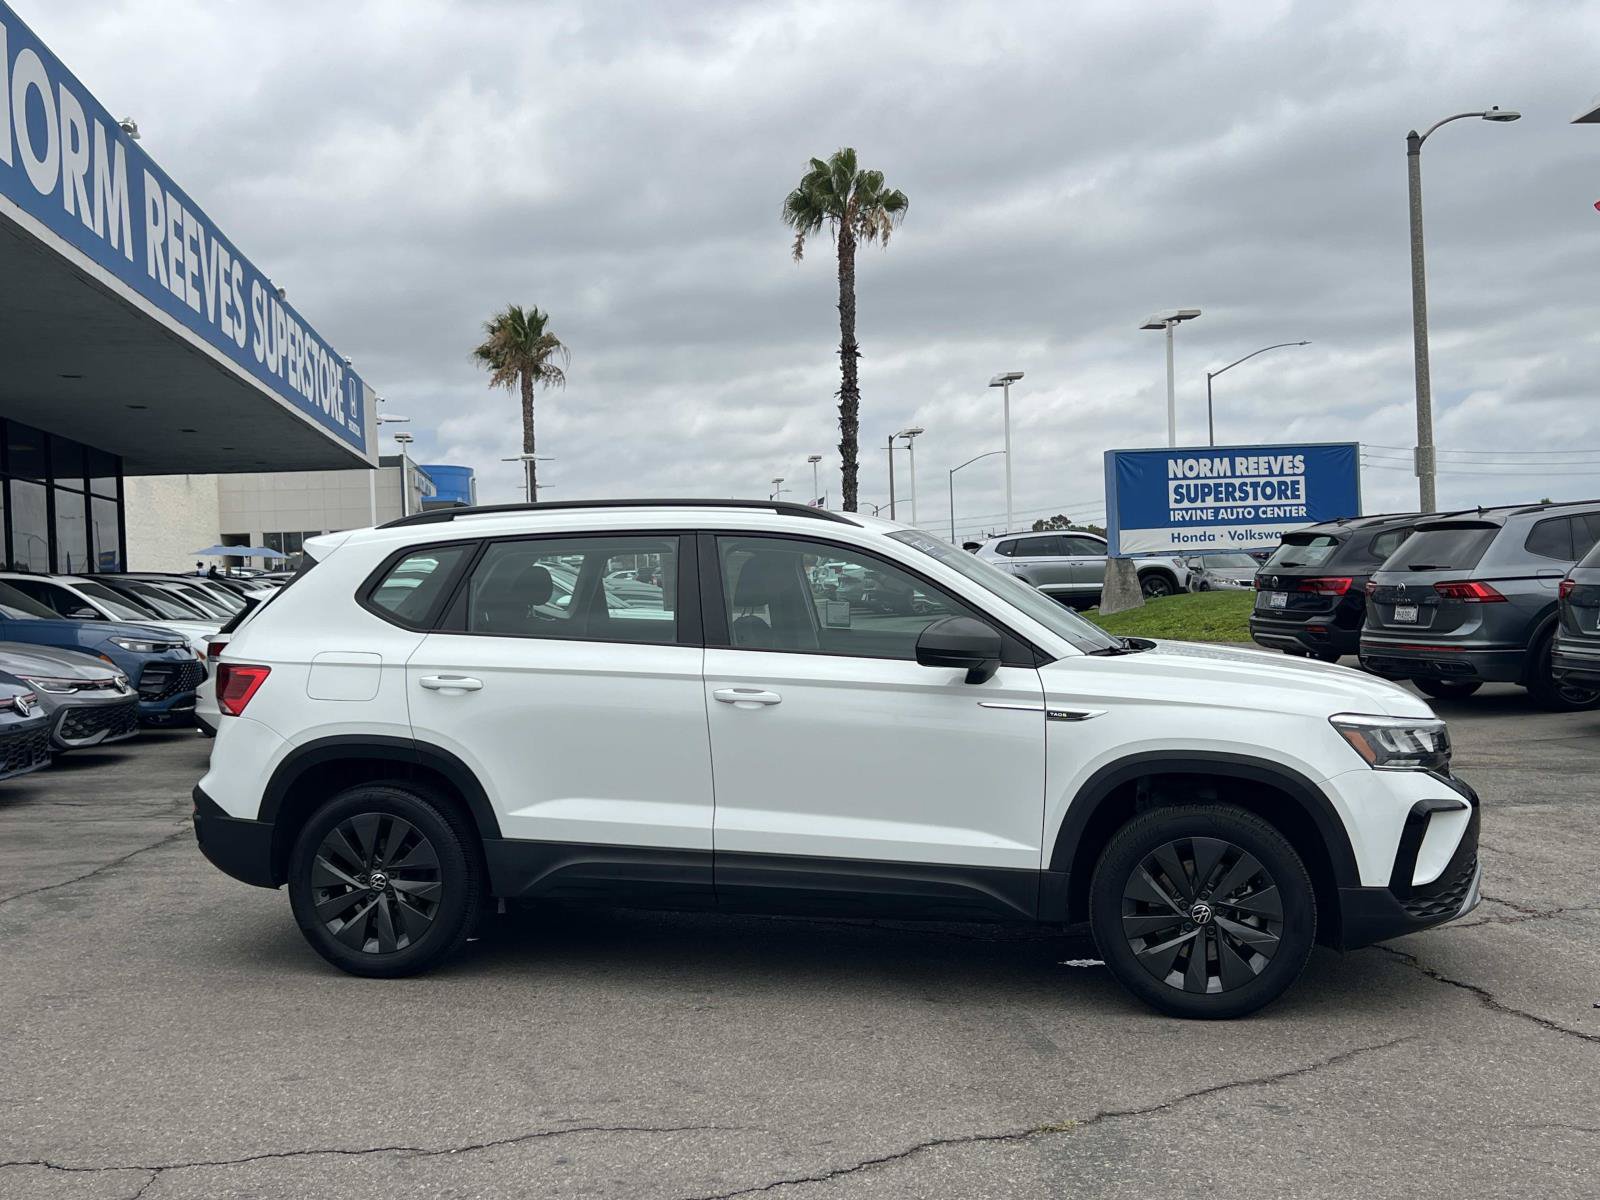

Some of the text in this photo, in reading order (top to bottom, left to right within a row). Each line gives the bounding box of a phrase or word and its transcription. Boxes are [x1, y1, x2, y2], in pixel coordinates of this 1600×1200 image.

[0, 20, 345, 426] ORM REEVES SUPERSTORE
[1168, 455, 1305, 478] NORM REEVES
[1173, 480, 1300, 504] SUPERSTORE
[1170, 506, 1307, 521] IRVINE AUTO CENTER
[1171, 529, 1287, 543] Honda Volkswa
